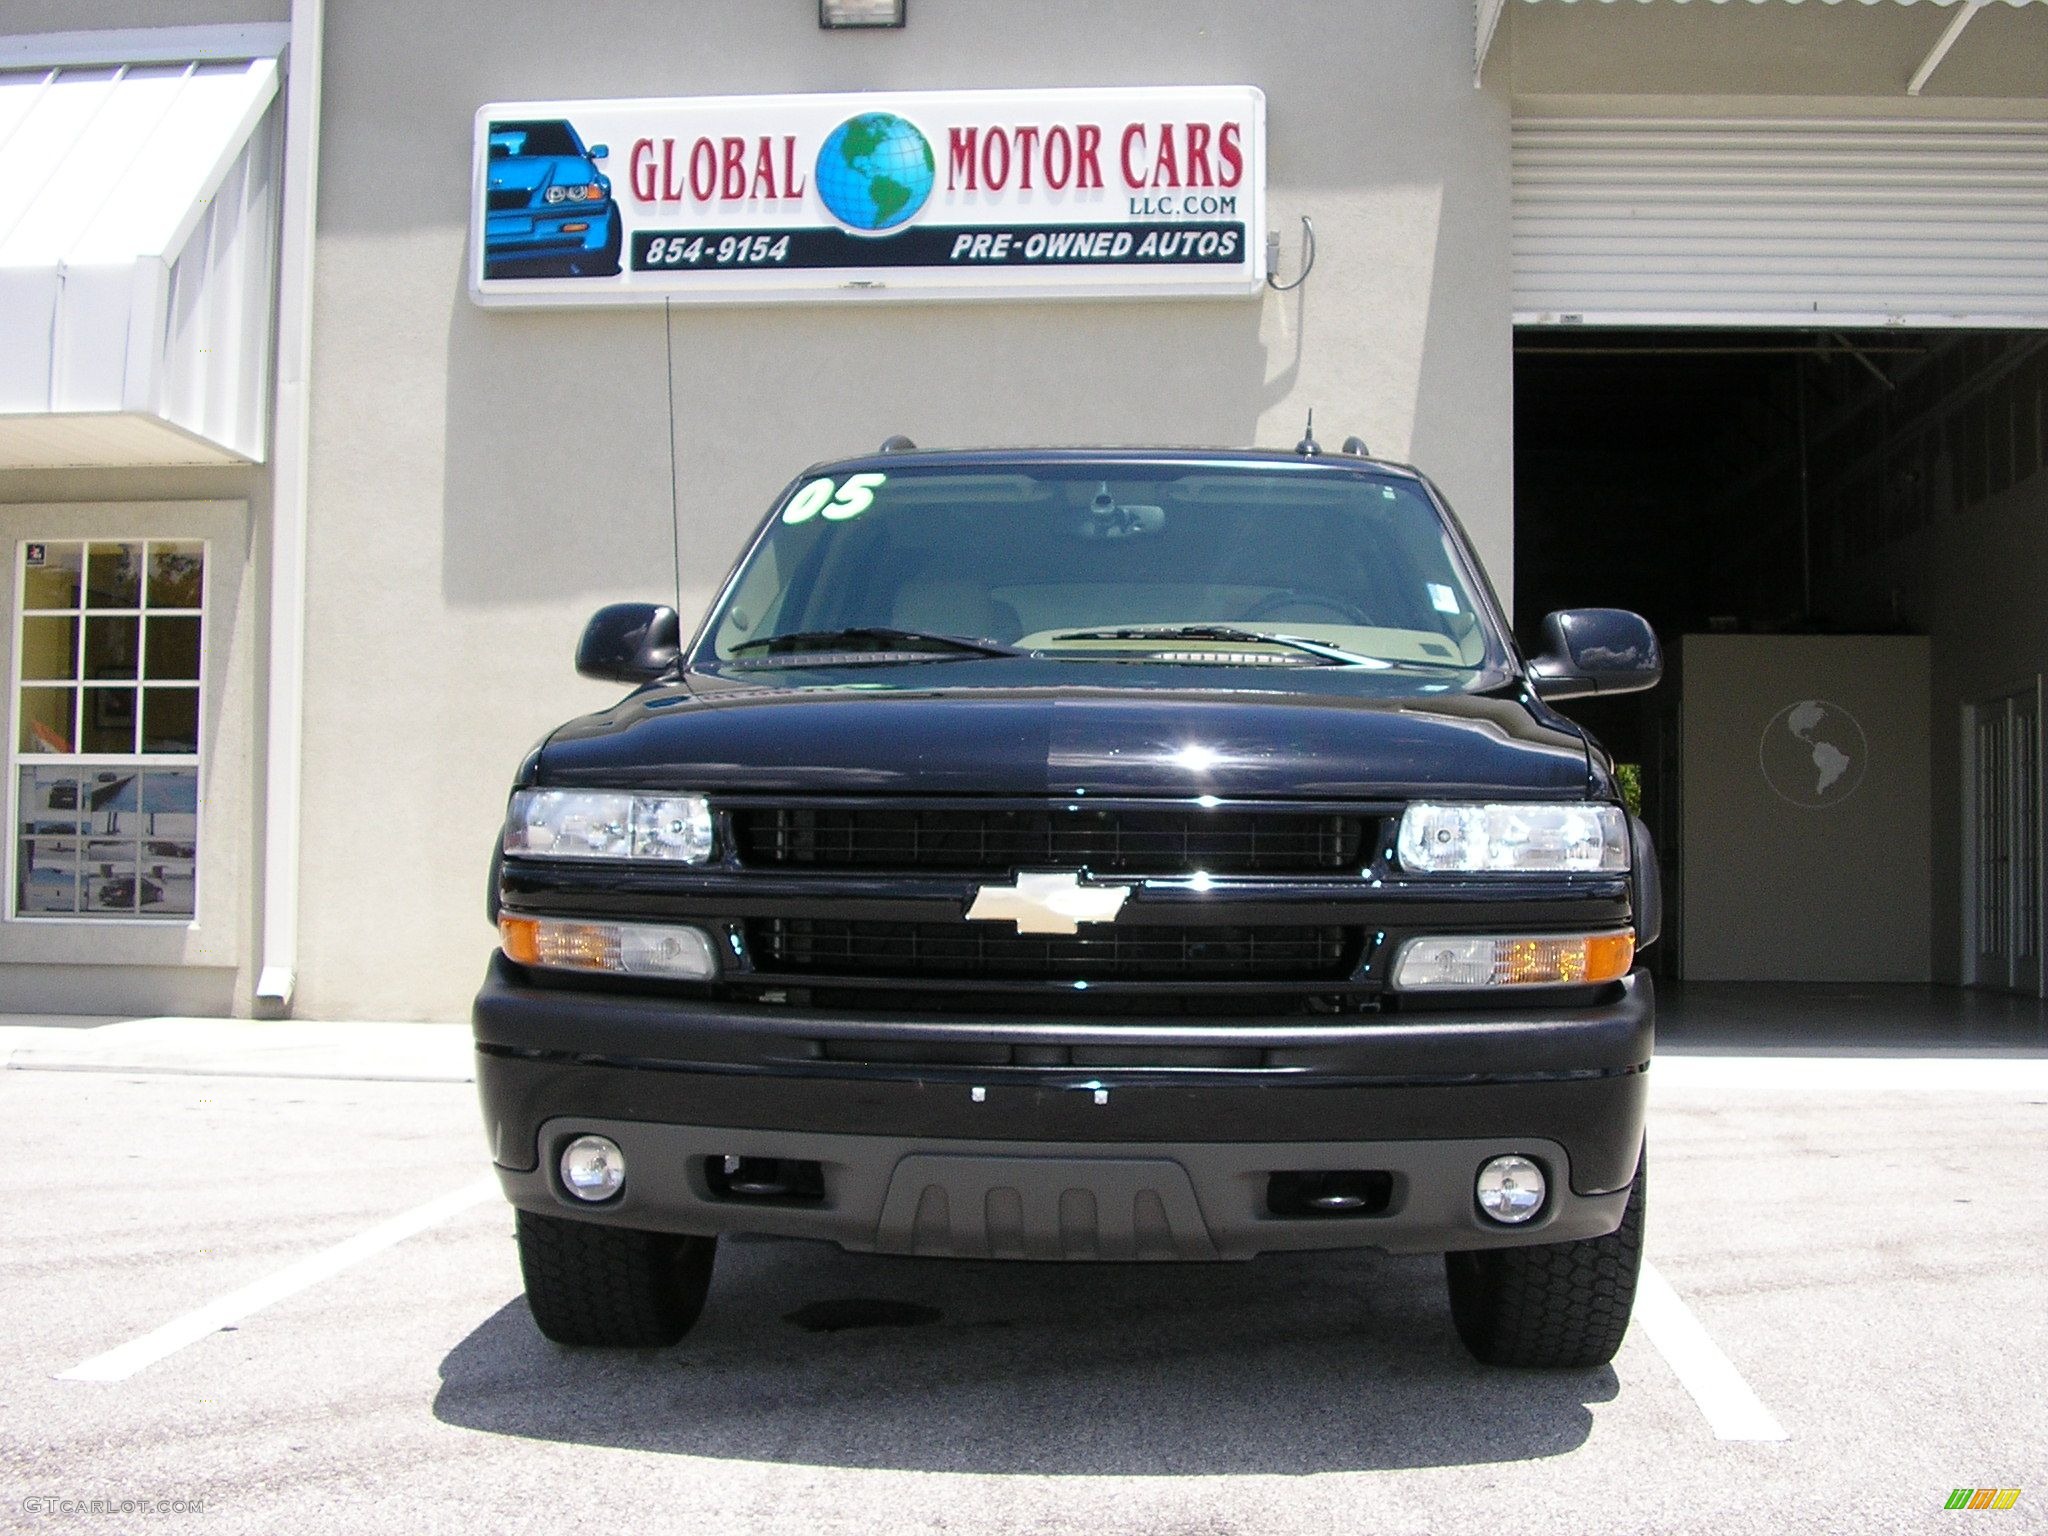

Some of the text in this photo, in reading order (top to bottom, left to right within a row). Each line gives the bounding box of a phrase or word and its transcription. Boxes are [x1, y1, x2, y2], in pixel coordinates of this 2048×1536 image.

[630, 122, 1243, 202] GLOBAL MOTOR CARS
[1130, 196, 1236, 215] LLC.COM
[646, 236, 789, 263] 854-9154
[950, 230, 1237, 259] PRE-OWNED AUTOS
[783, 473, 887, 525] 05
